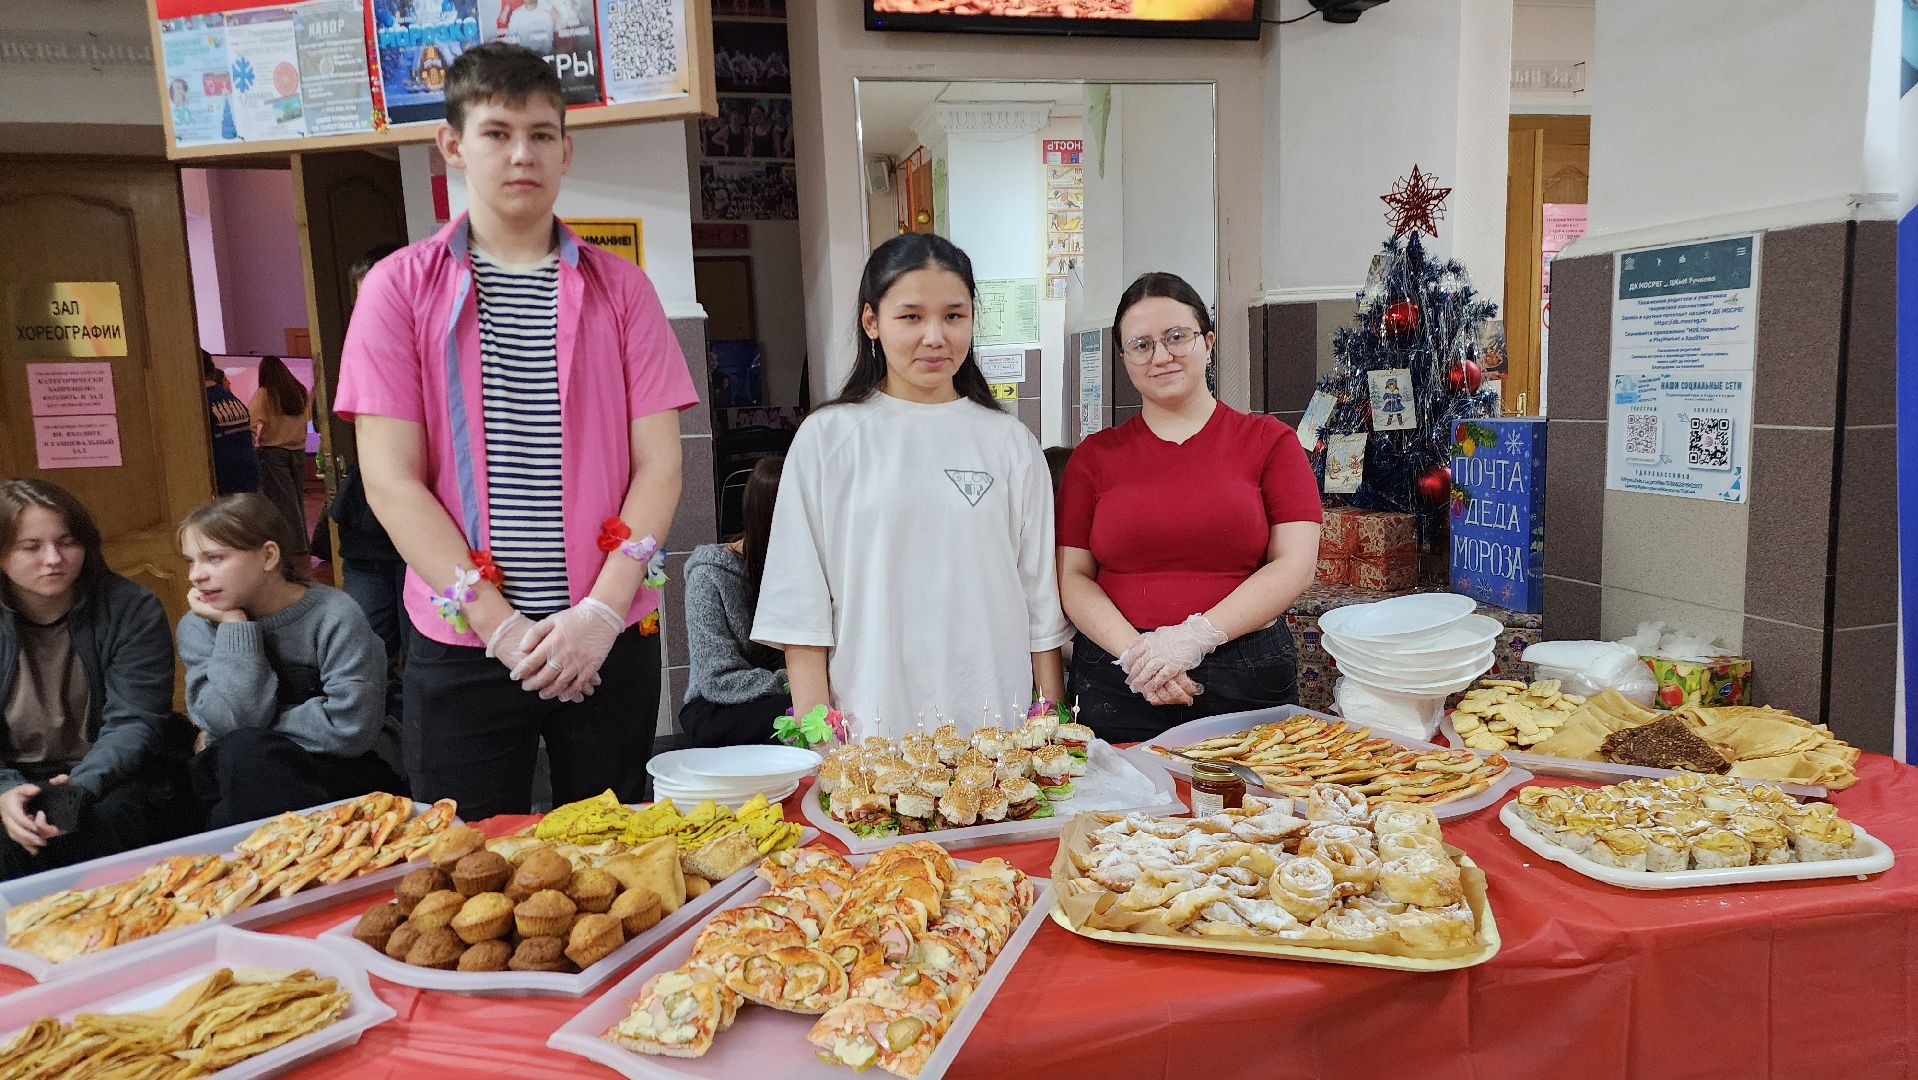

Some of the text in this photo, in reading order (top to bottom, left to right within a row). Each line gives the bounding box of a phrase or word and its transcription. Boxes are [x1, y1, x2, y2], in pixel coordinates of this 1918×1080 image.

[308, 19, 345, 36] НАБОР
[1638, 281, 1663, 290] МОСРЕГ
[51, 300, 80, 316] ЗАЛ
[1721, 306, 1745, 314] МОСРЕГ
[16, 324, 122, 341] ХОРЕОГРАФИИ
[1661, 382, 1742, 391] НАШИ СОЦИАЛЬНЫЕ СЕТИ
[1455, 457, 1524, 493] ПОЧТА
[1464, 498, 1520, 533] ДЕДА
[1453, 534, 1524, 583] МОРОЗА
